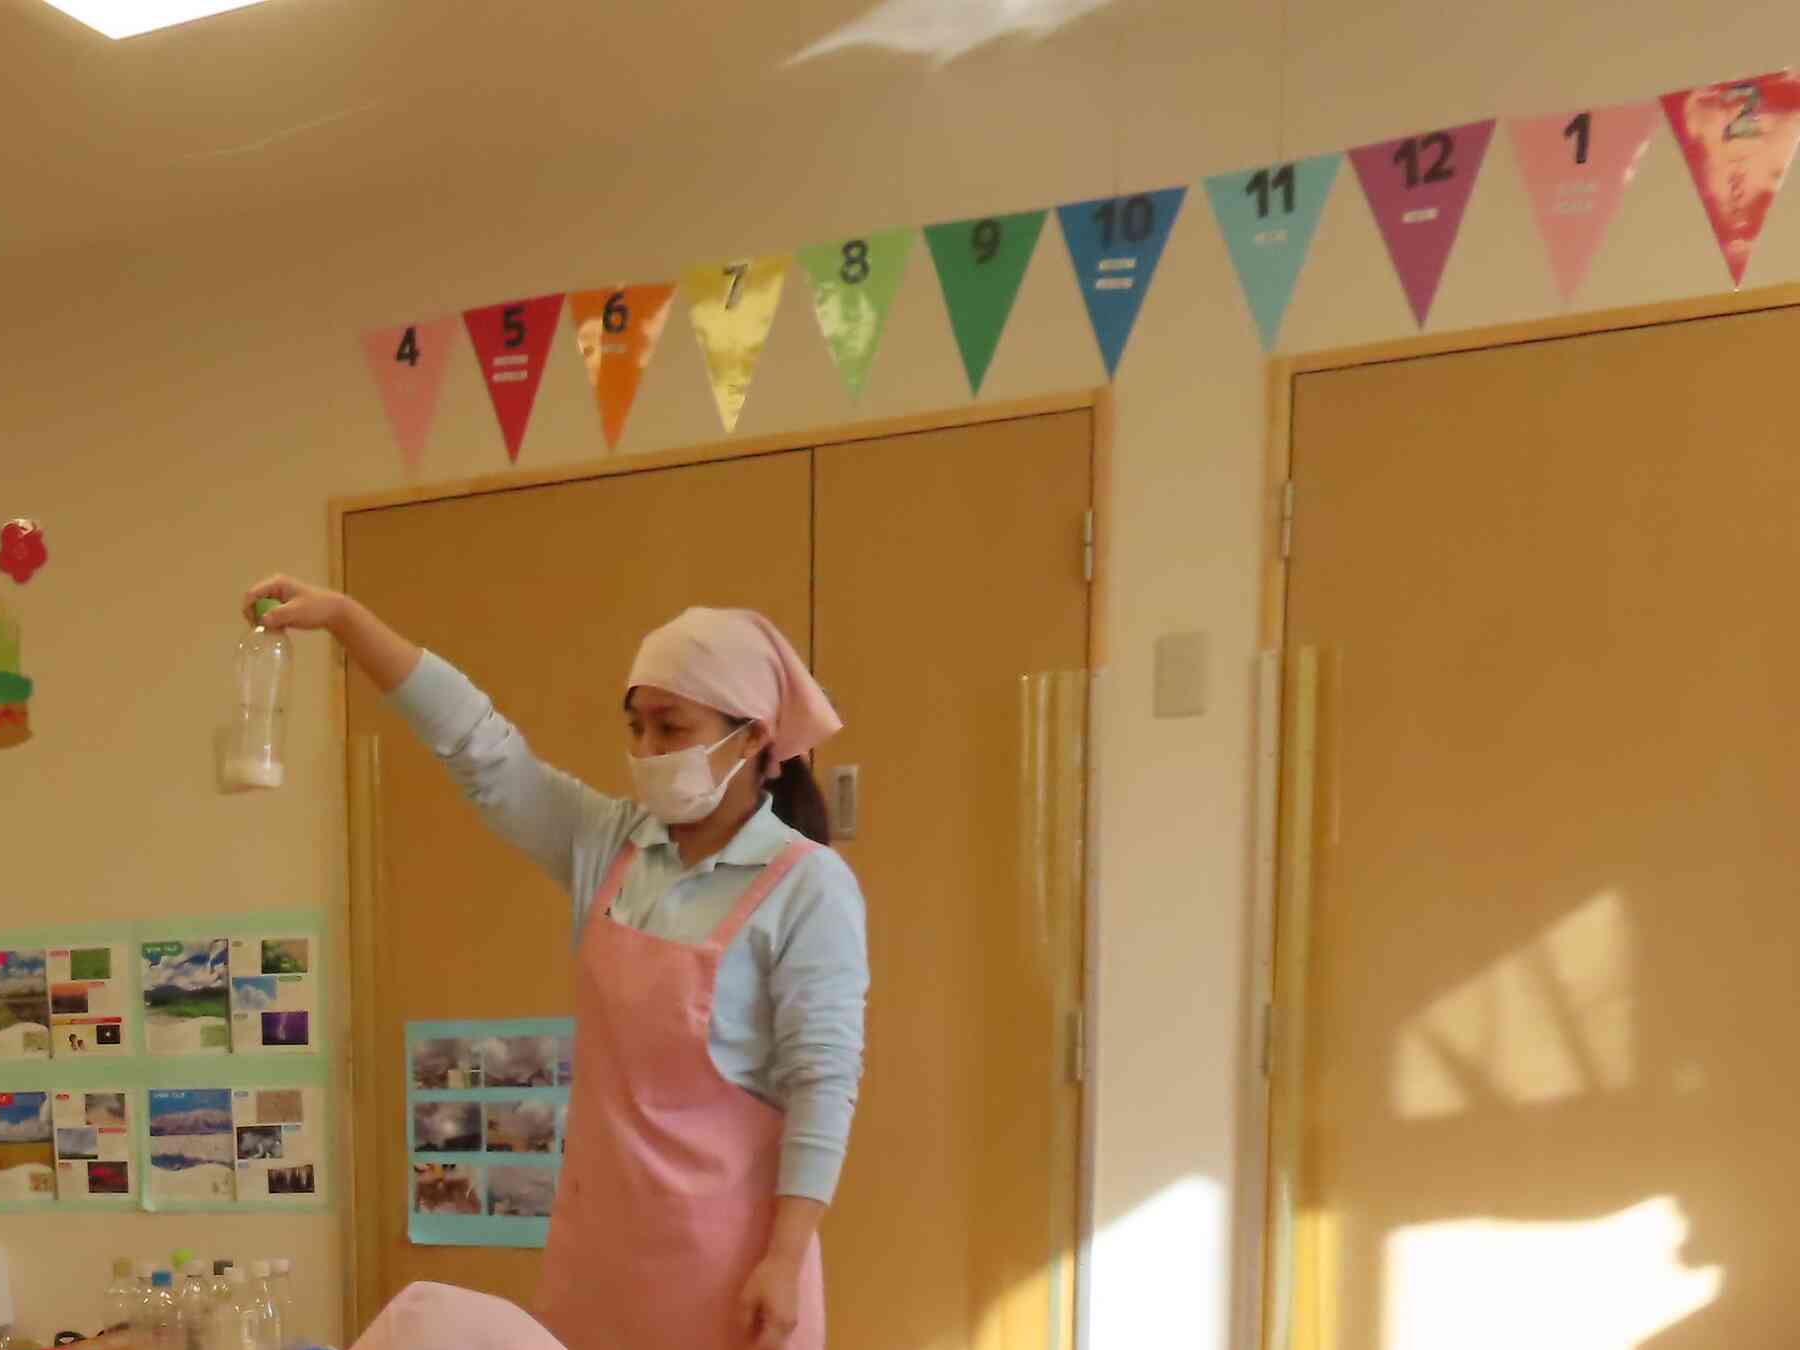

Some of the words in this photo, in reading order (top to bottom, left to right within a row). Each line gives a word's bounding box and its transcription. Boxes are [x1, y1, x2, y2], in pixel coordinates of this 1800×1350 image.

[1721, 83, 1762, 141] 2
[1393, 131, 1455, 188] 12
[1564, 112, 1591, 165] 1
[1244, 163, 1296, 219] 11
[971, 218, 1002, 264] 9
[1091, 196, 1154, 247] 10
[722, 262, 749, 311] 7
[840, 240, 870, 285] 8
[503, 308, 527, 348] 5
[602, 292, 628, 334] 6
[395, 327, 420, 367] 4
